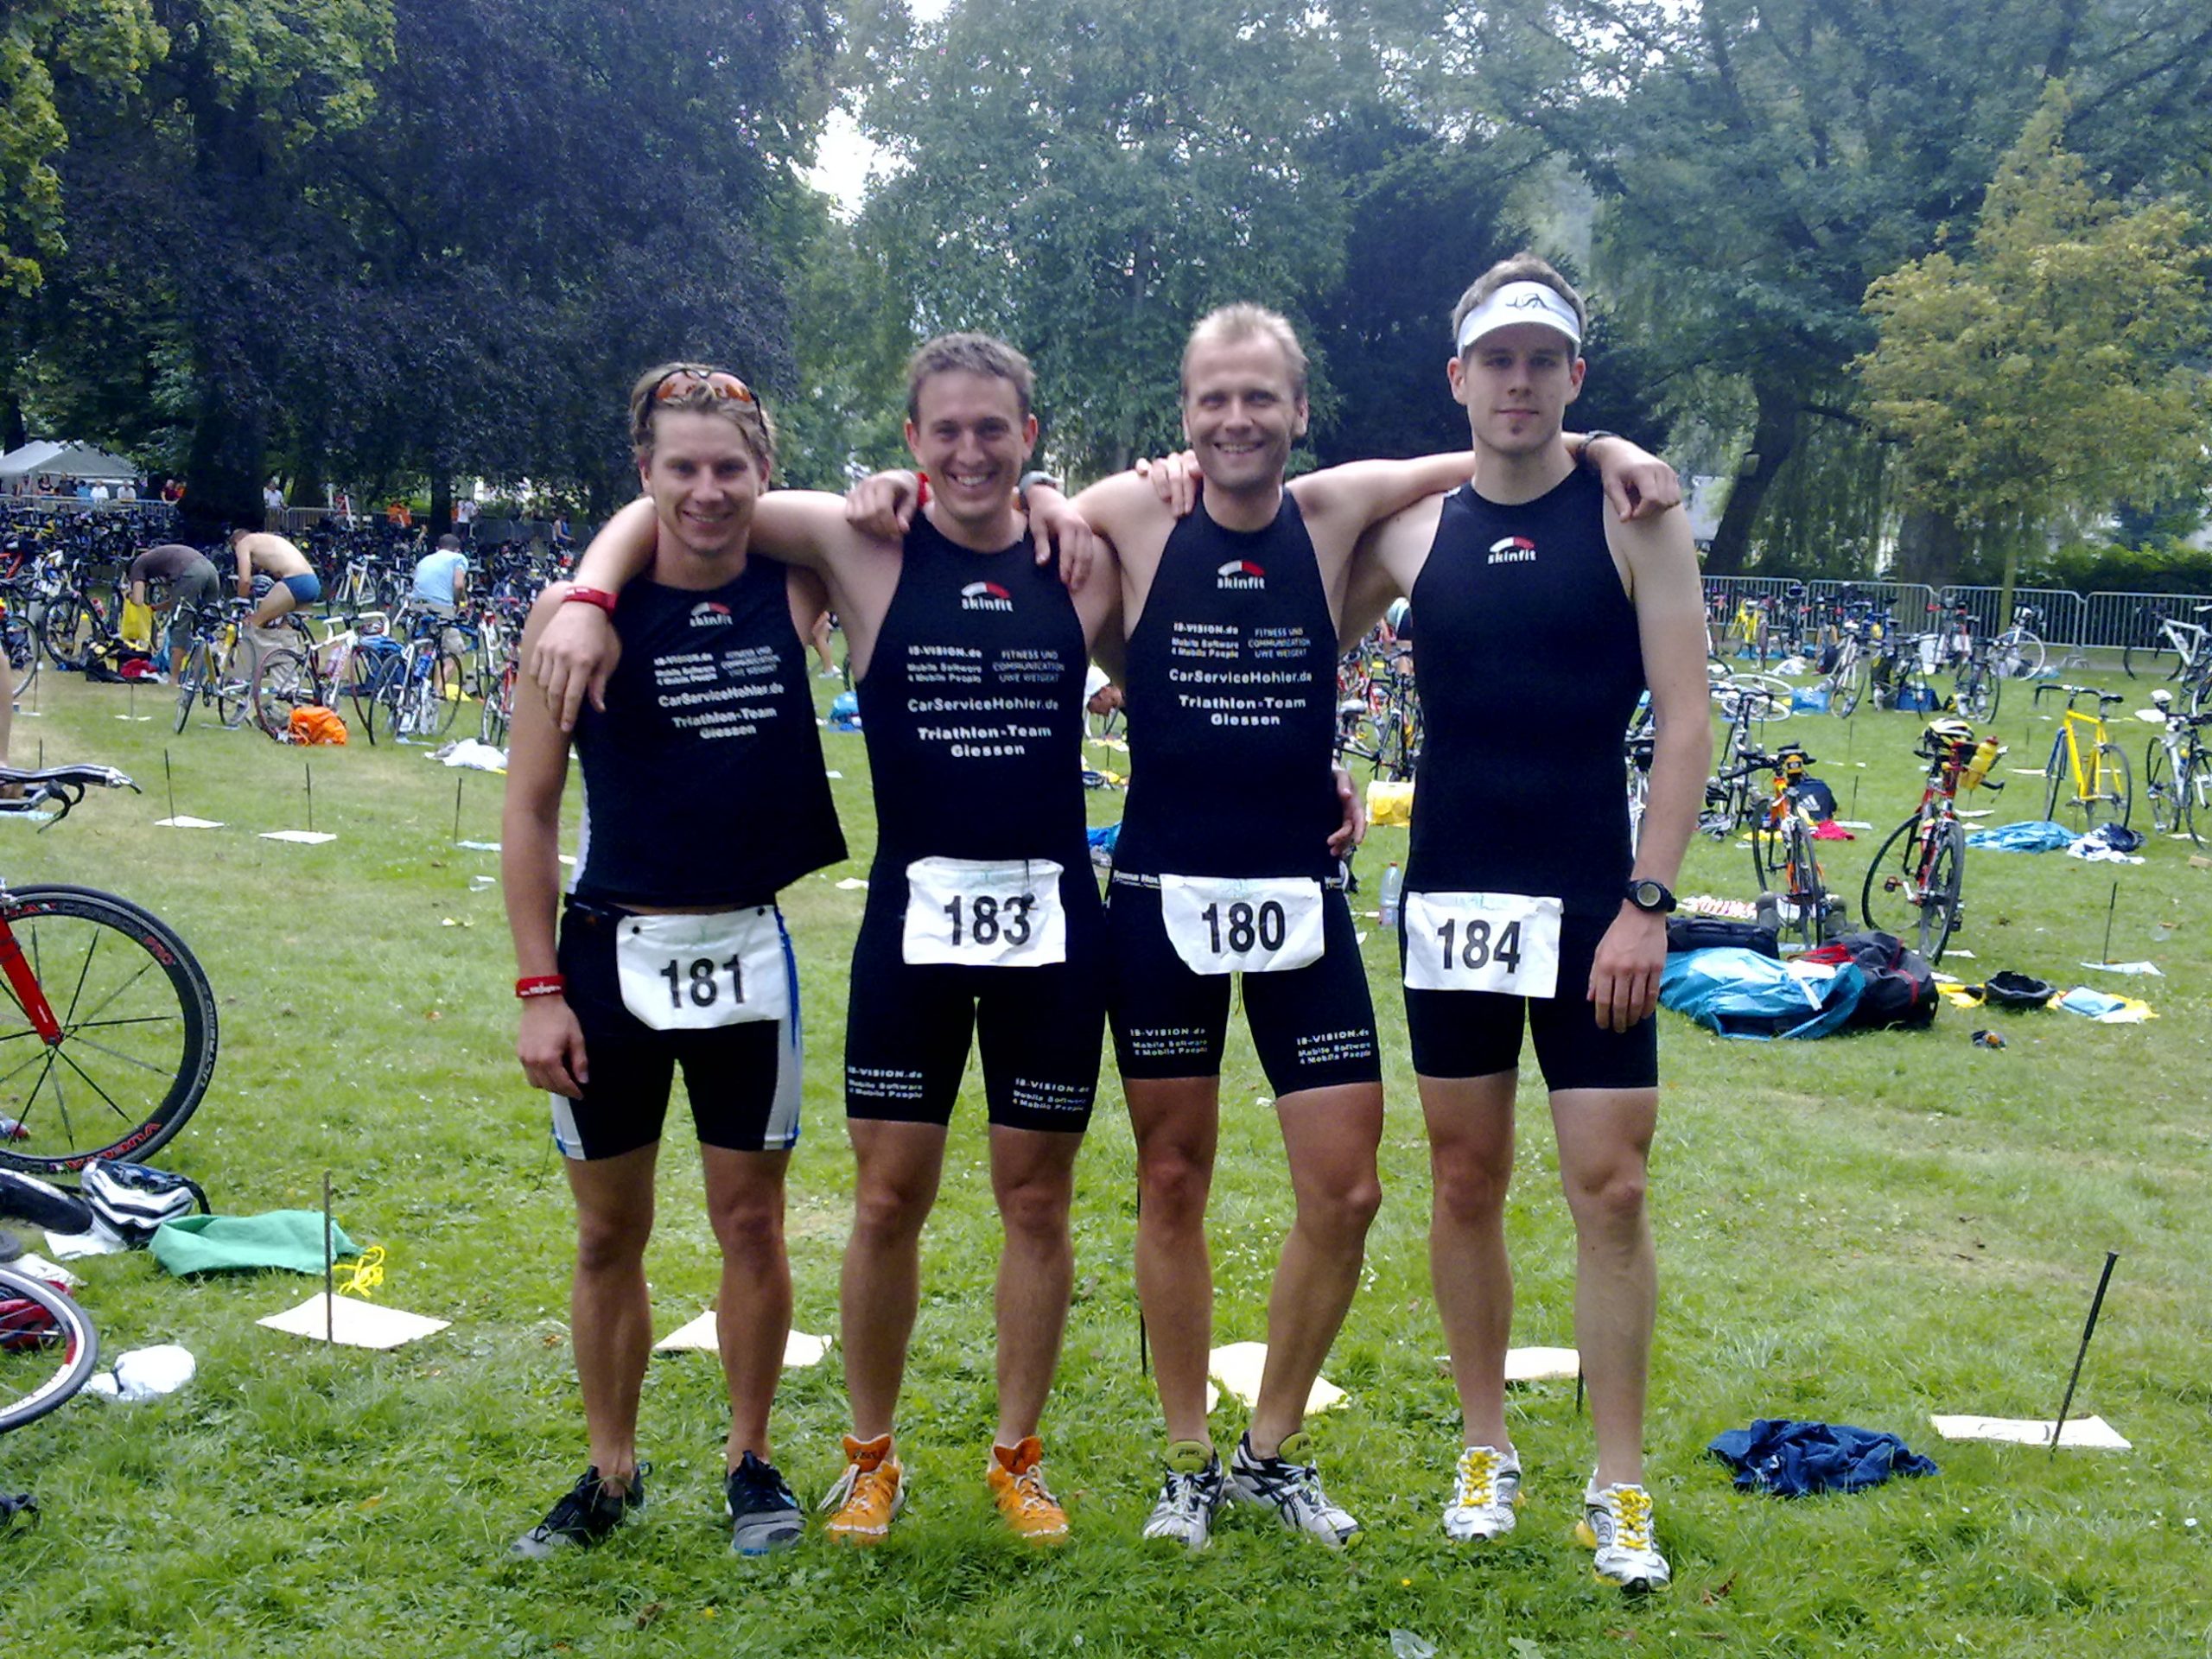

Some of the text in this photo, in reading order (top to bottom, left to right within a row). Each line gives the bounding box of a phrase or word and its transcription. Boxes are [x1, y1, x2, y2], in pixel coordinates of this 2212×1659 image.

[961, 597, 1014, 612] skinfit
[944, 894, 1031, 946] 183
[1201, 899, 1286, 954] 180
[1437, 918, 1522, 975] 184
[660, 954, 745, 1008] 181
